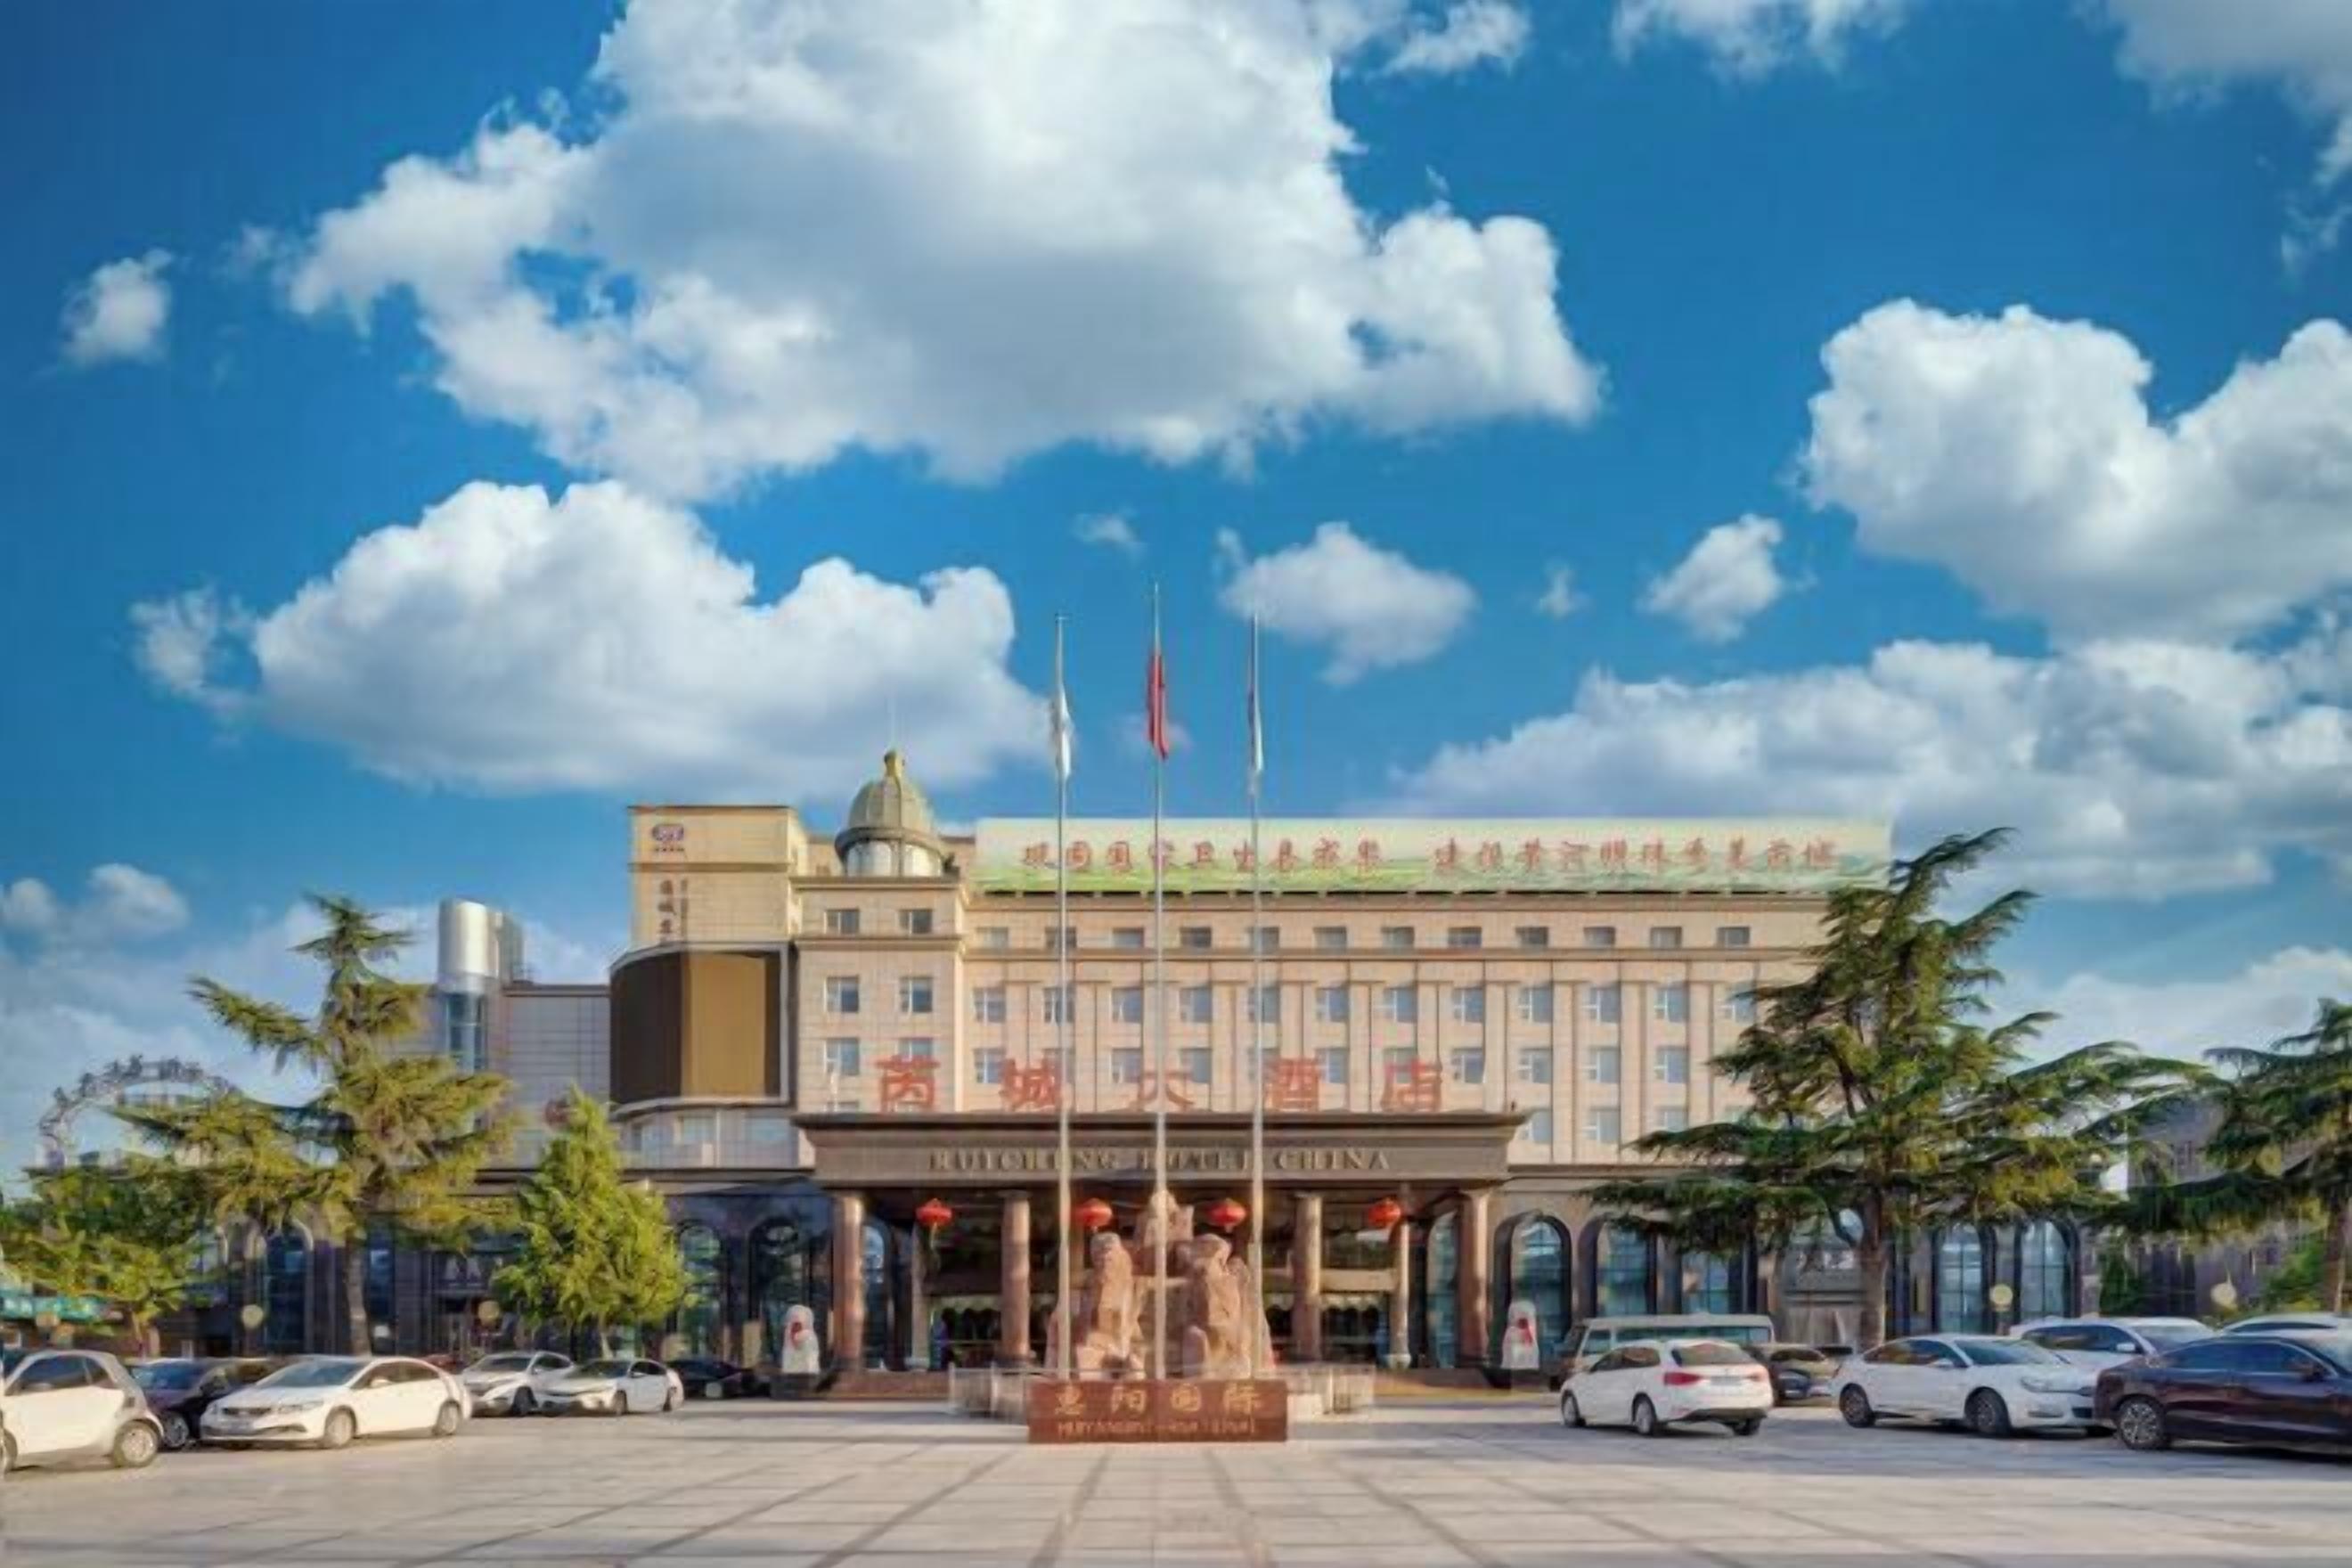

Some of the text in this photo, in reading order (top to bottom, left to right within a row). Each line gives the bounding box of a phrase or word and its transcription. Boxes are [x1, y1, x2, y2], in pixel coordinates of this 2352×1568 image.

[876, 1056, 1442, 1112] 芮城大酒店
[1274, 1147, 1390, 1171] CHINA
